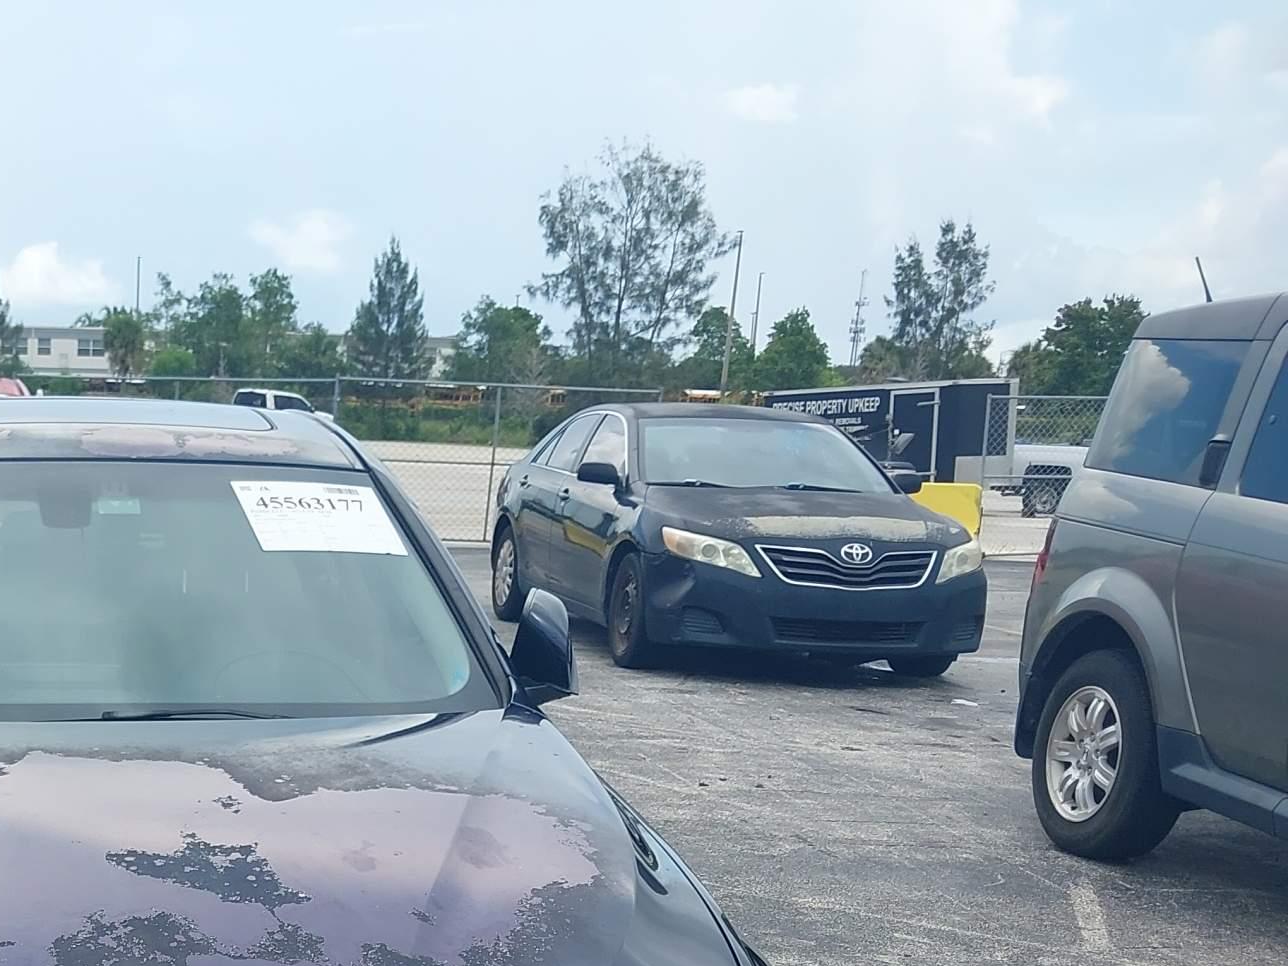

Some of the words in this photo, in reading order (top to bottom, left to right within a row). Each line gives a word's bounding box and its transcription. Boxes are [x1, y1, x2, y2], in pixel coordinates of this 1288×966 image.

[806, 399, 847, 415] PROPERTY
[848, 397, 881, 413] UPKEEP
[256, 496, 363, 512] 45563177
